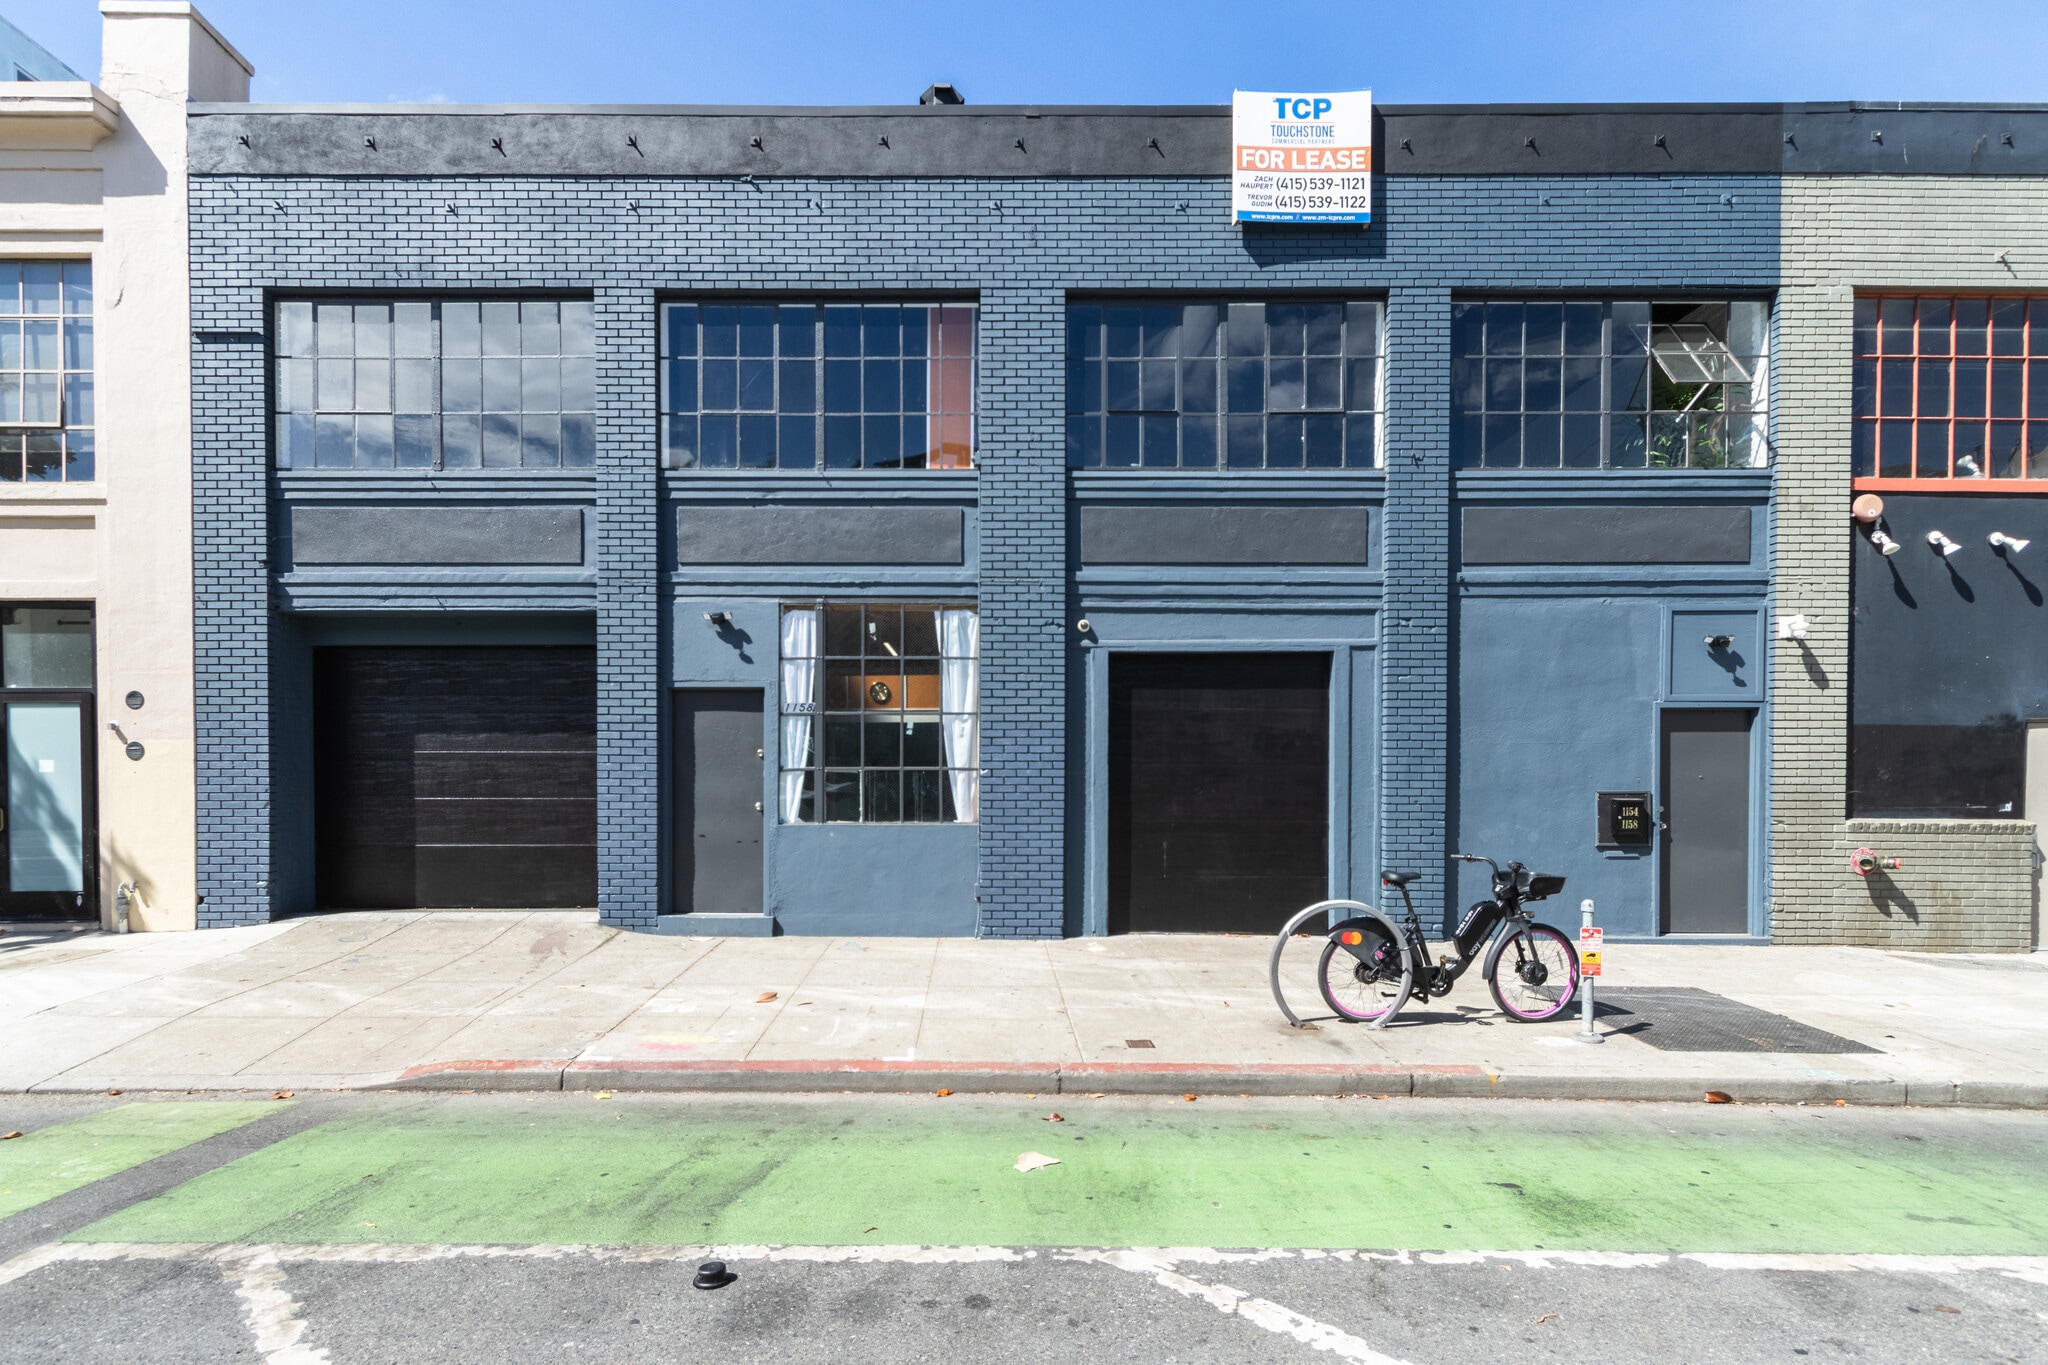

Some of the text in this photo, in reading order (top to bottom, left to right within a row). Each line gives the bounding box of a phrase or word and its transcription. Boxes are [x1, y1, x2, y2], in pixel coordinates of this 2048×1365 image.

[1275, 98, 1332, 120] TCP
[1271, 125, 1335, 138] TOUCHSTONE
[1241, 149, 1366, 170] FOR LEASE
[1276, 177, 1365, 191] (415) 539-1121
[1275, 195, 1366, 210] (415) 539-1122
[1251, 213, 1293, 221] www.tcpre.com
[1622, 806, 1639, 817] 1154
[1621, 819, 1639, 829] 1158
